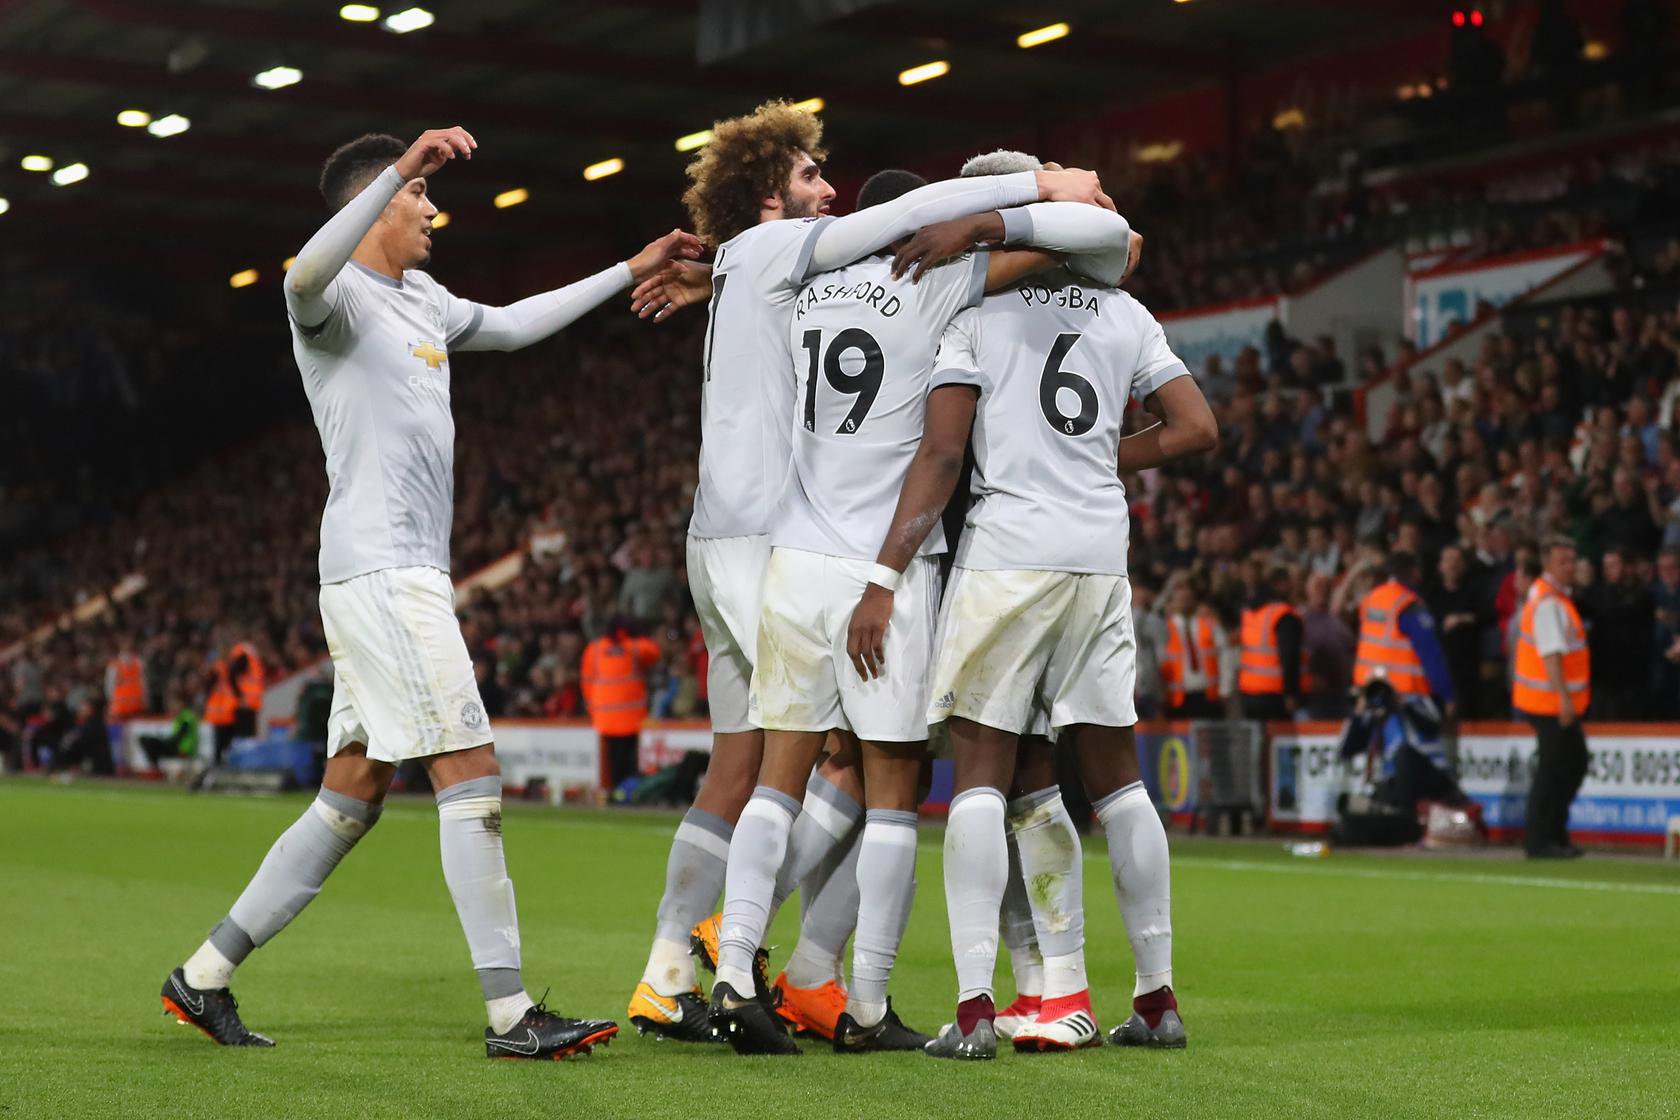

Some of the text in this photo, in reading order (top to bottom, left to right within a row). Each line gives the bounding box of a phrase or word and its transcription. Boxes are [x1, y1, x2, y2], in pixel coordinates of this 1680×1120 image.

[796, 281, 901, 321] RASHFORD
[1018, 284, 1100, 318] POGBA
[802, 327, 885, 435] 19
[1039, 332, 1099, 437] 6
